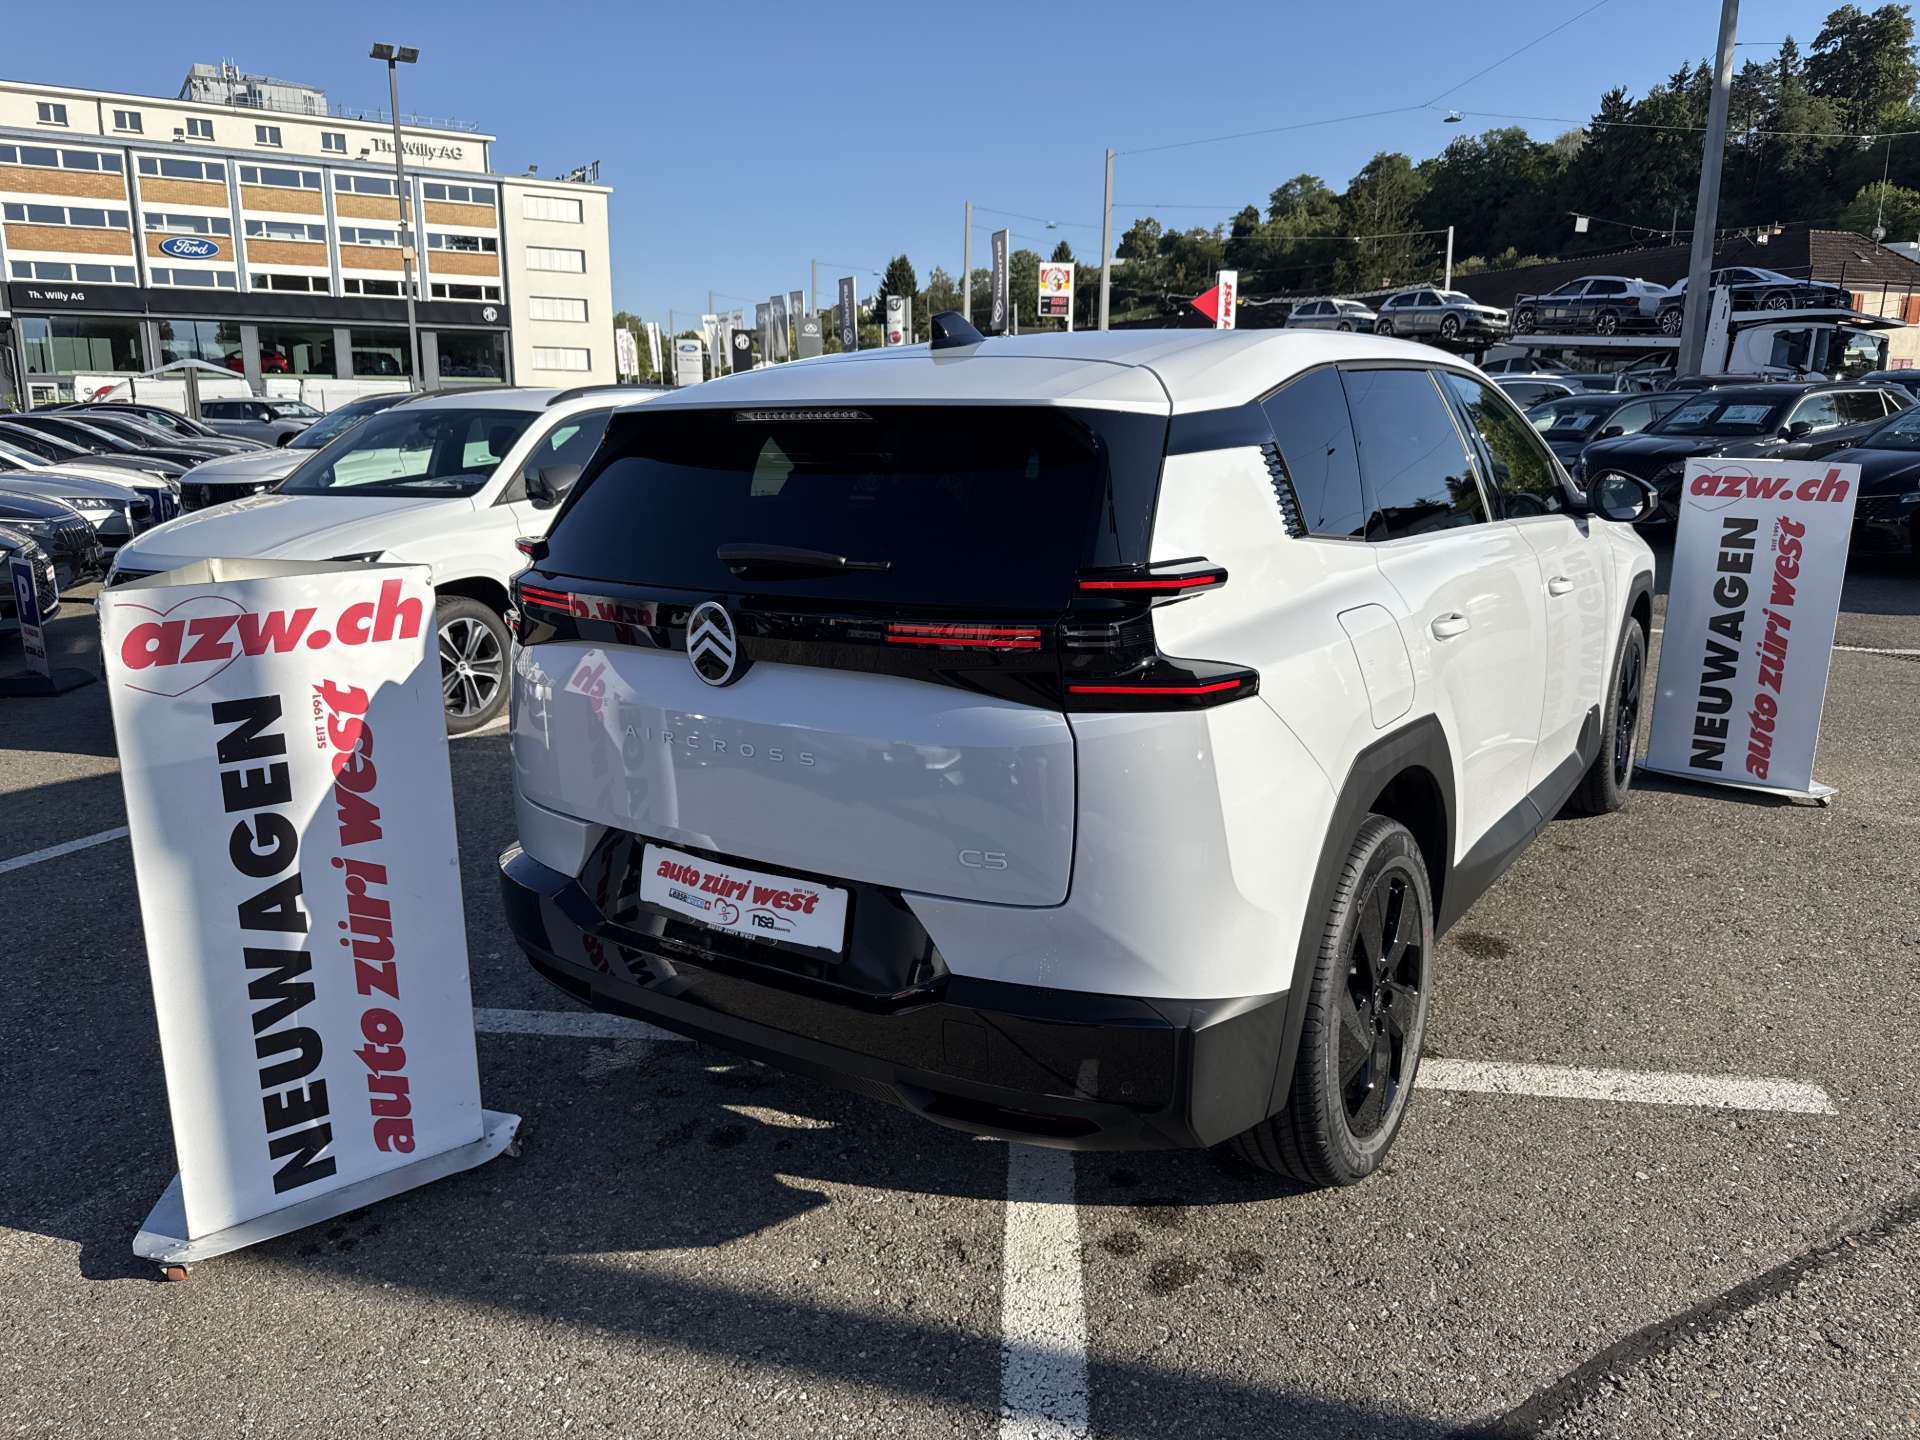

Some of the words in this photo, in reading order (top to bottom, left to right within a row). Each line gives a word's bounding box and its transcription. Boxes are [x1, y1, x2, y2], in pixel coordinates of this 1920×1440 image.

[438, 146, 463, 160] AG
[173, 239, 209, 256] Ford
[27, 290, 43, 299] Th.
[45, 291, 68, 302] Willy
[71, 292, 85, 301] AG
[1690, 469, 1850, 503] azw.ch
[1770, 515, 1806, 606] west
[17, 575, 31, 616] P
[121, 580, 422, 670] azw.ch
[1689, 517, 1759, 771] NEUWAGEN
[1756, 608, 1791, 695] züri
[312, 693, 325, 718] 1991
[316, 721, 328, 750] SEIT
[625, 724, 815, 767] AIRCROSS
[1745, 693, 1778, 780] auto
[313, 678, 384, 845] west
[959, 849, 1008, 870] C5
[656, 860, 701, 888] auto
[699, 872, 753, 901] züri
[752, 885, 820, 914] west
[212, 694, 337, 1195] NEUWAGEN
[331, 857, 401, 1000] züri
[752, 913, 775, 930] nsa
[353, 1007, 416, 1154] auto
